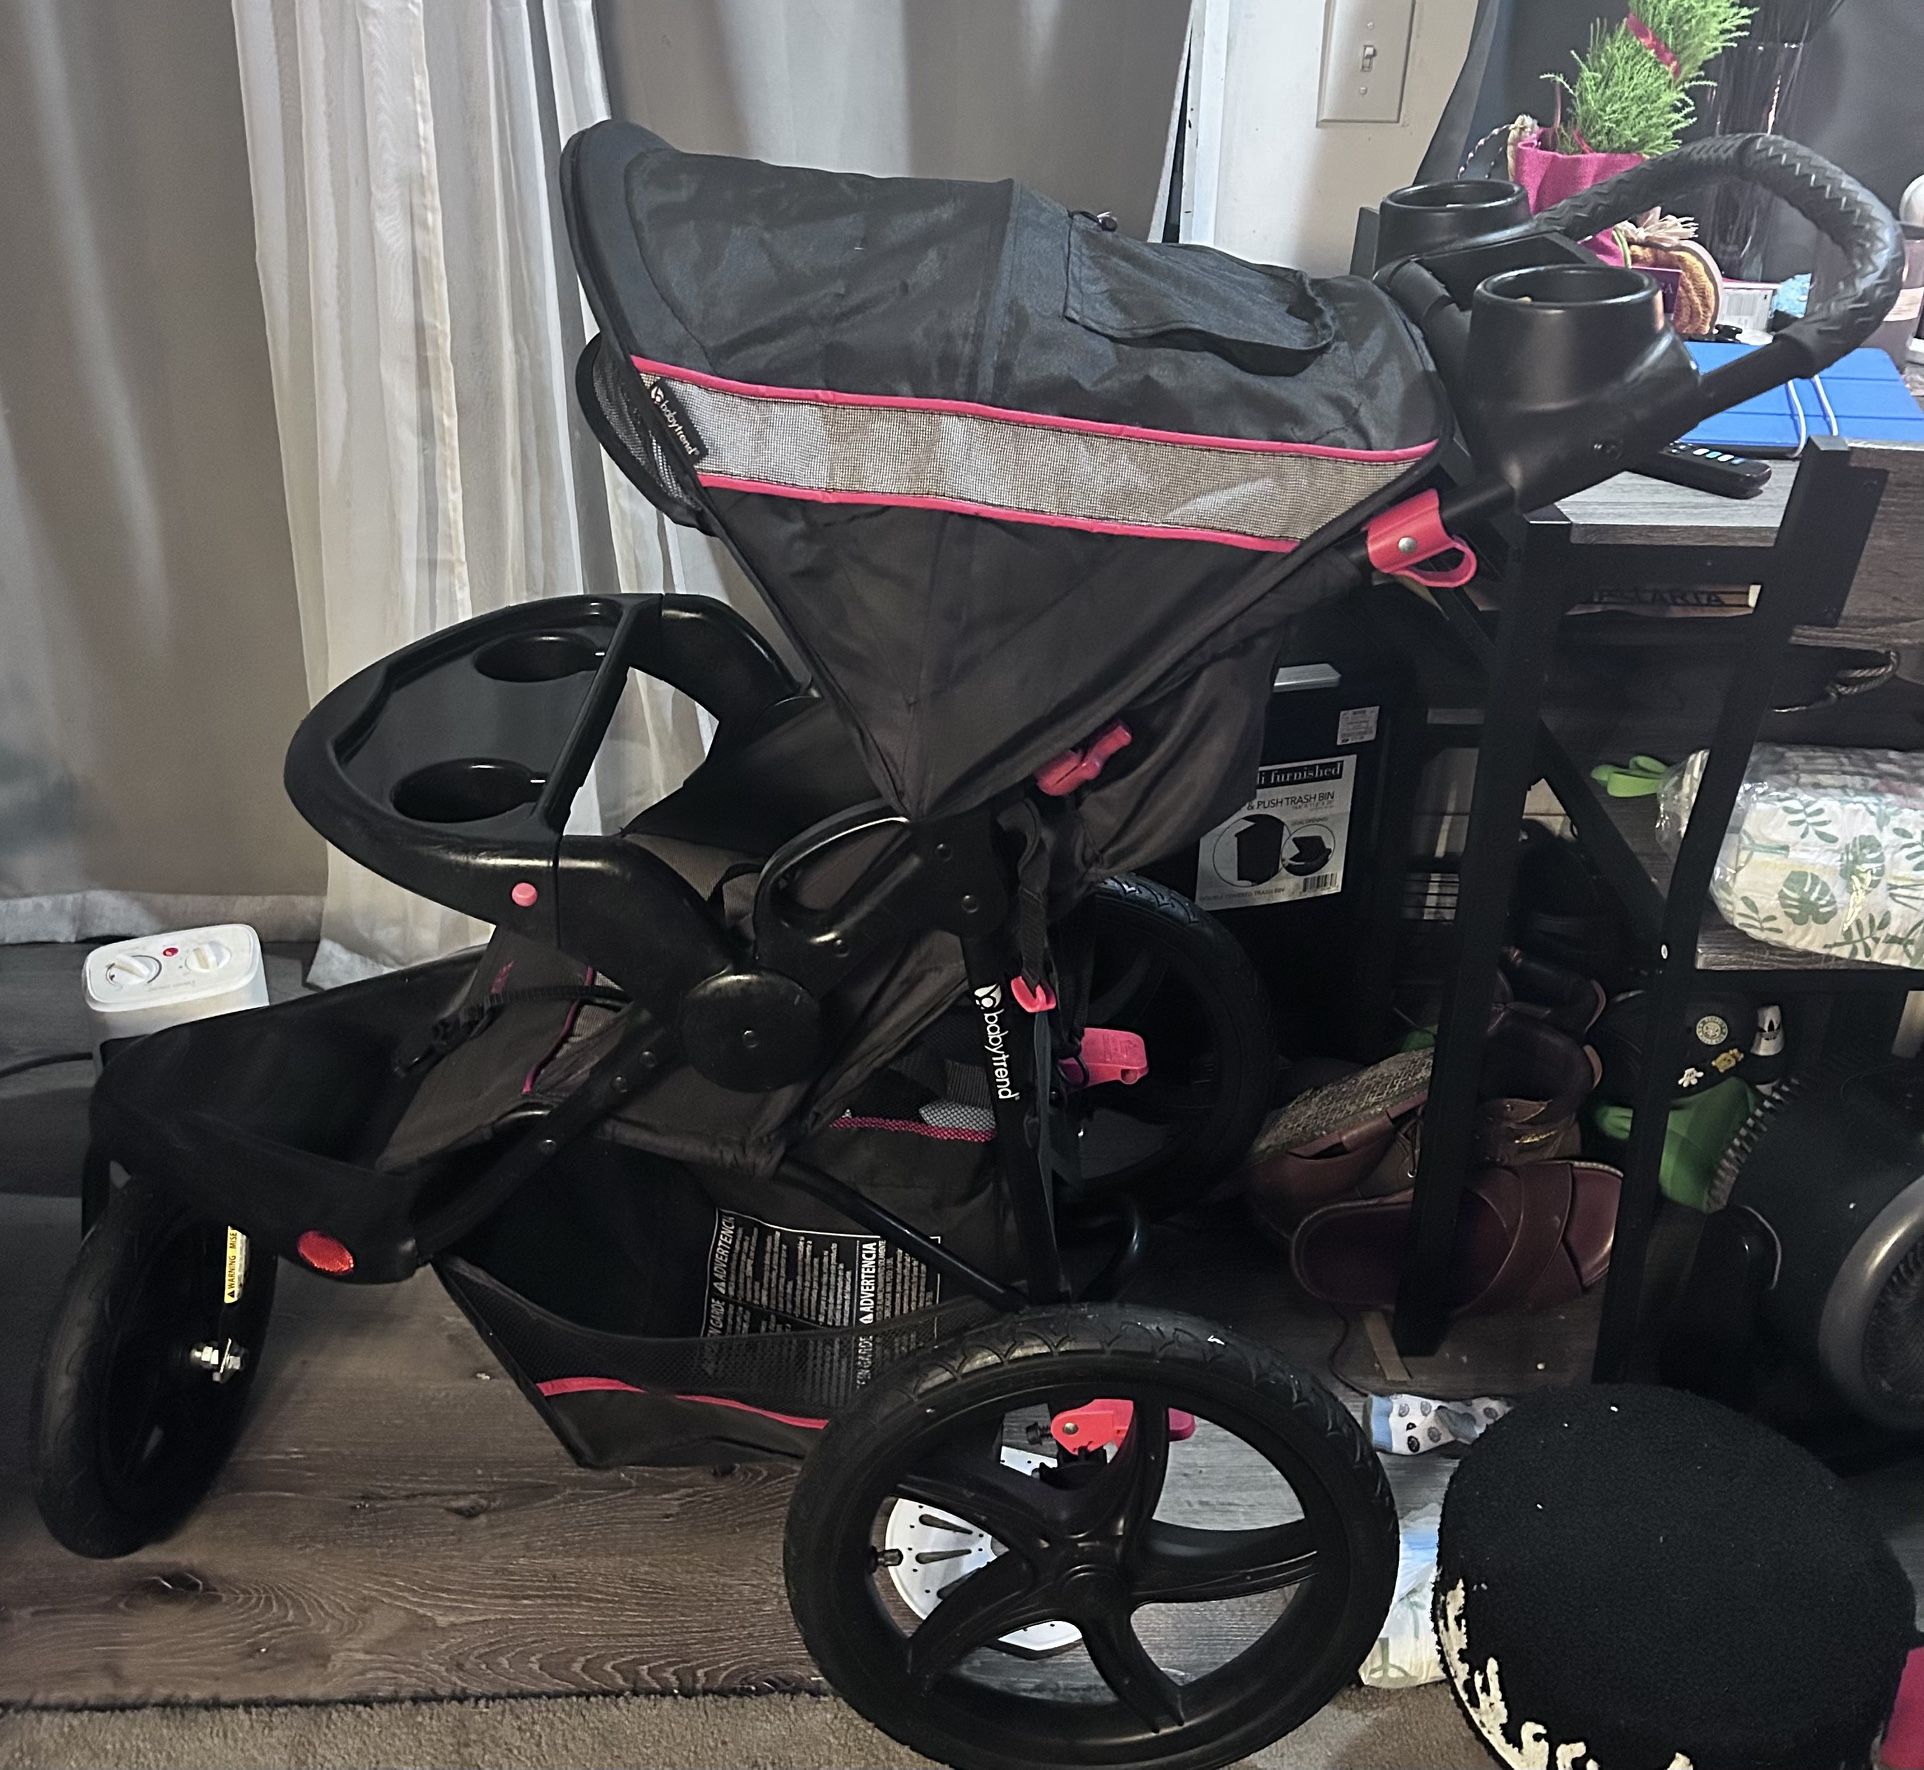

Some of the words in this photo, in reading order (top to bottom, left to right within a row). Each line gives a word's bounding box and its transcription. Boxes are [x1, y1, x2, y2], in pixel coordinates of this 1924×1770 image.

[660, 400, 698, 455] babytrend
[1270, 762, 1342, 784] furnished
[1256, 798, 1283, 809] PUSH
[1284, 793, 1317, 806] TRASH
[1318, 790, 1335, 801] BIN
[983, 1008, 1020, 1099] babytrend
[229, 1232, 238, 1249] MISE
[228, 1255, 236, 1289] WARNING
[860, 1242, 876, 1313] ADVERTENCIA
